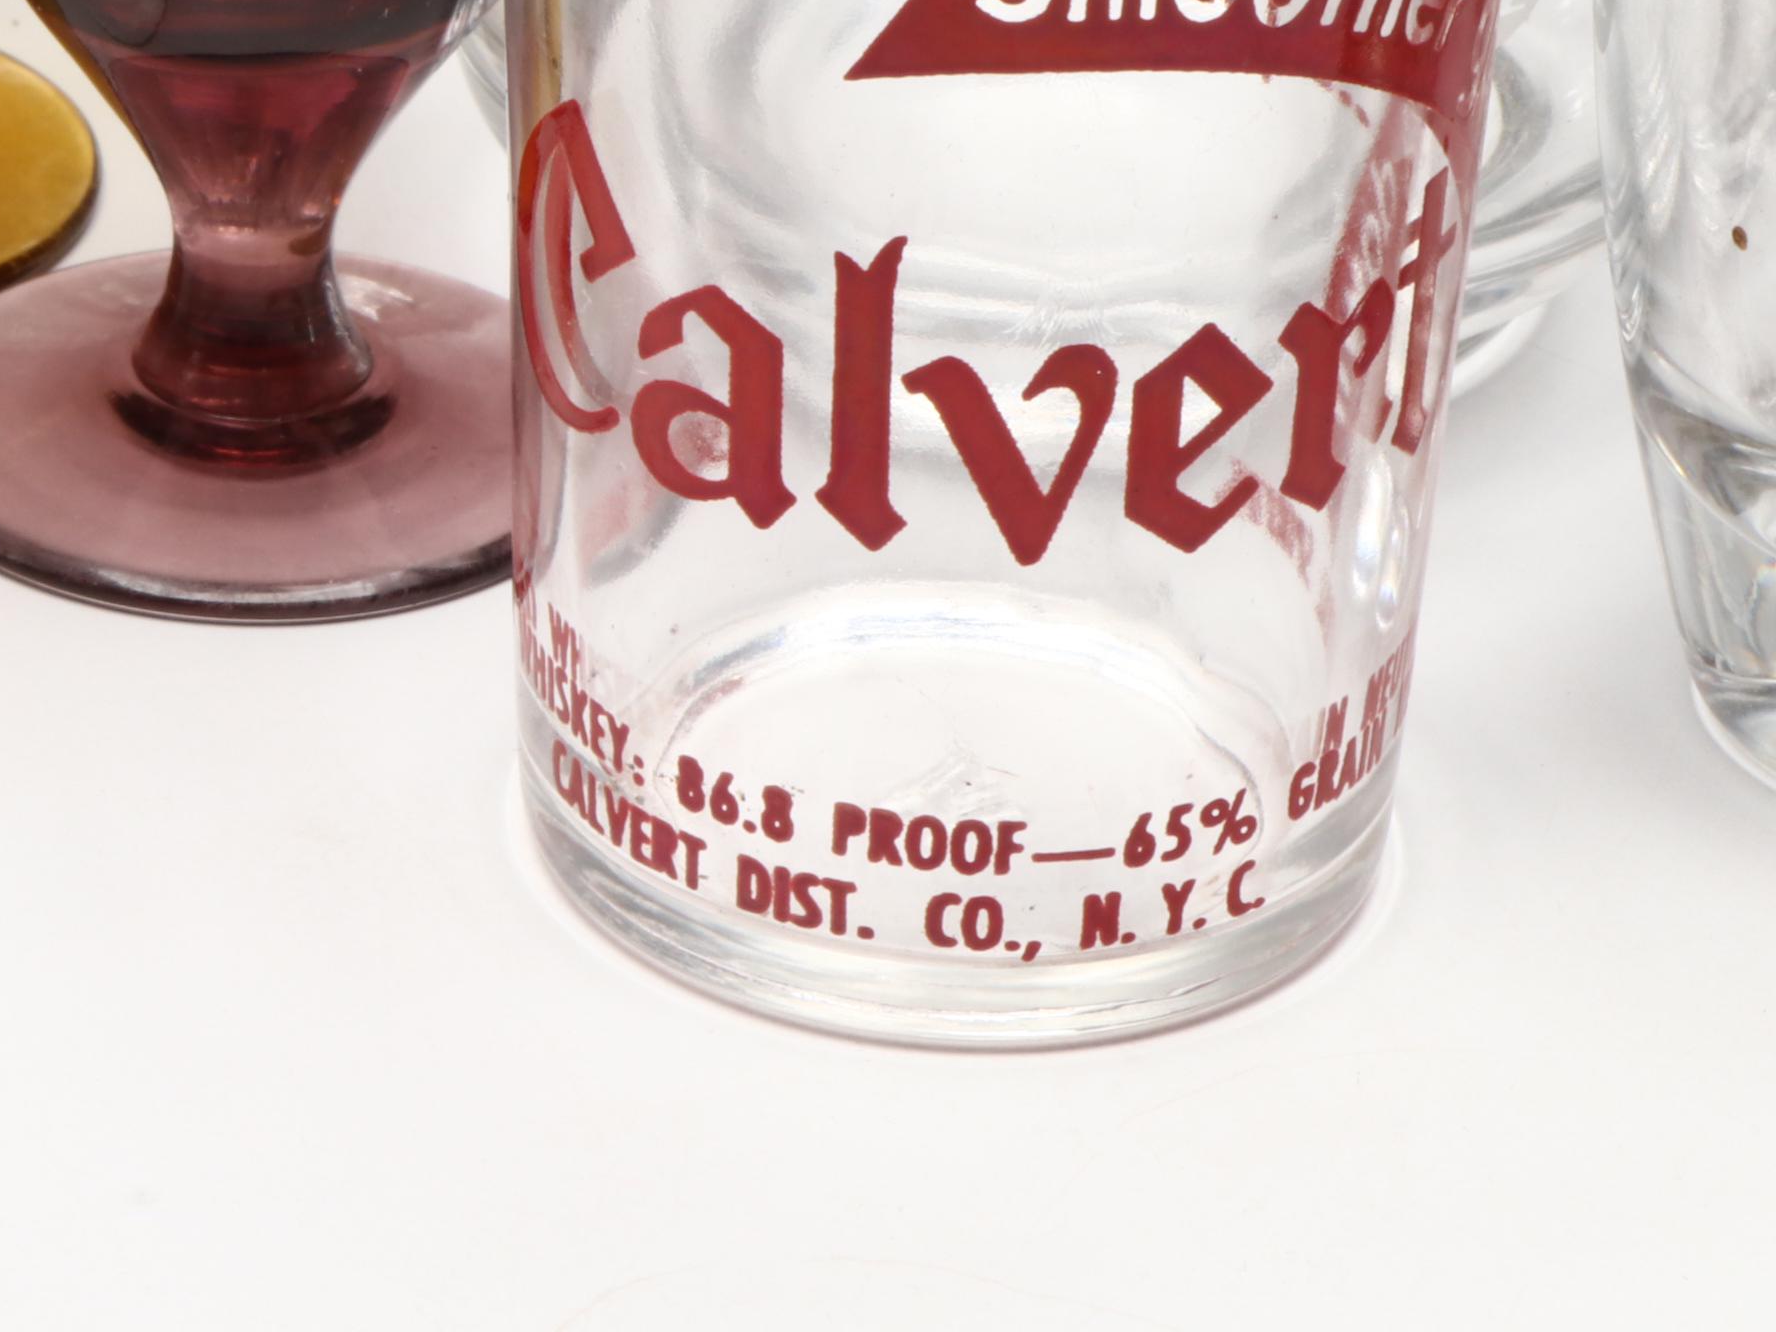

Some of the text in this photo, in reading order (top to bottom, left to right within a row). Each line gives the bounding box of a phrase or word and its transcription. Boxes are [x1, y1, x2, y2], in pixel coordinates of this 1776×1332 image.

[516, 98, 1456, 566] Calvert
[551, 739, 708, 891] CALVERT
[735, 854, 876, 940] DIST.
[923, 892, 1043, 962] CO.,
[1079, 891, 1137, 951] N.
[1161, 878, 1208, 936] Y.
[676, 754, 794, 843] 86.8
[1287, 708, 1390, 821] GRAIN
